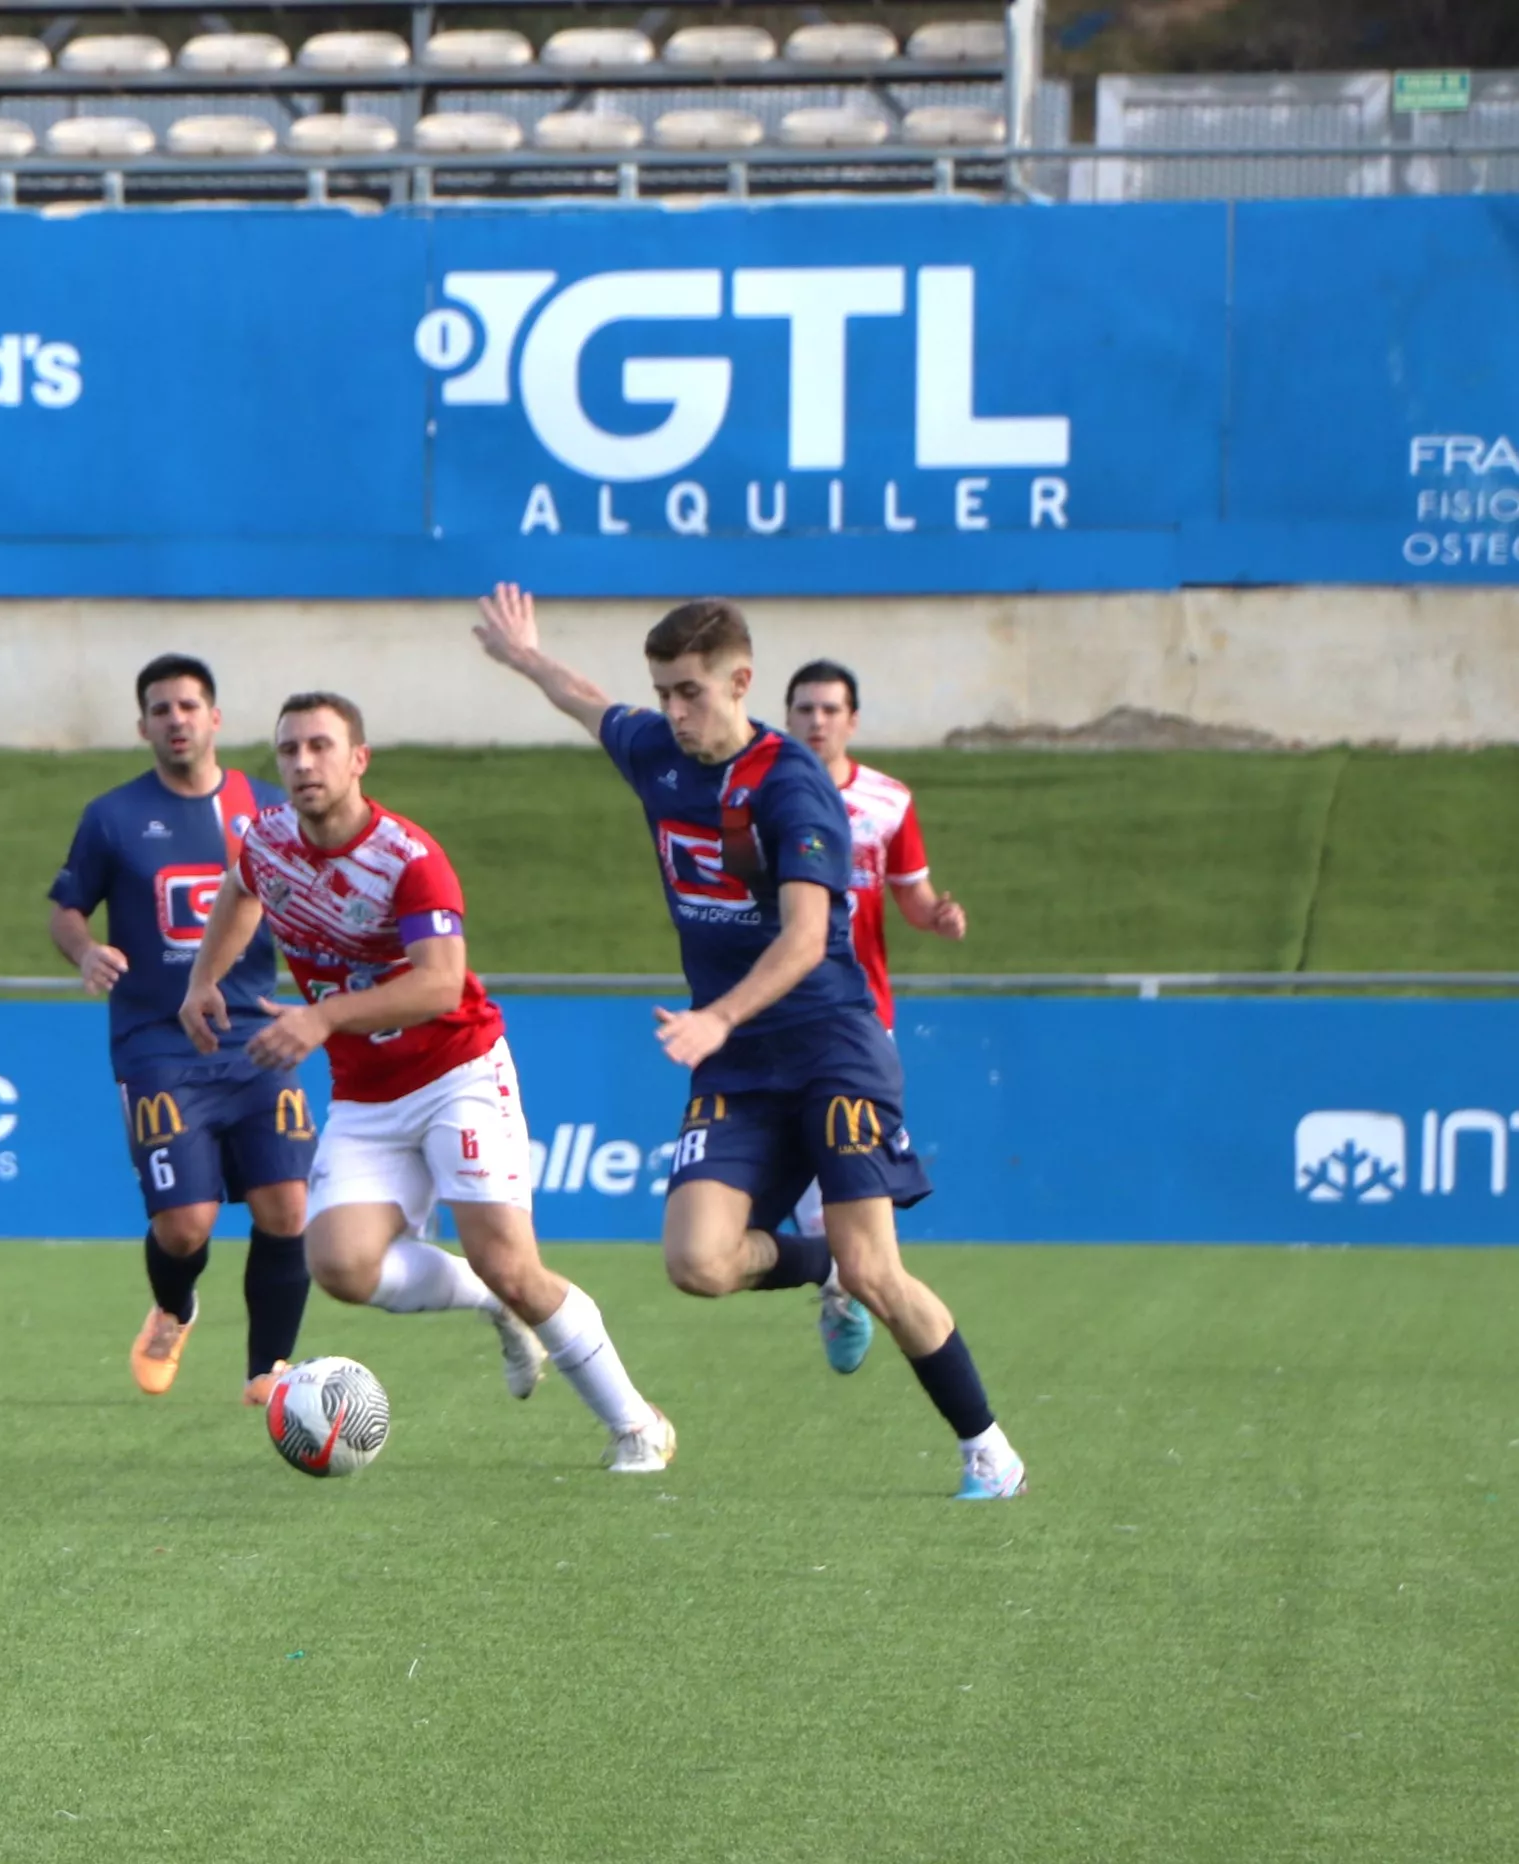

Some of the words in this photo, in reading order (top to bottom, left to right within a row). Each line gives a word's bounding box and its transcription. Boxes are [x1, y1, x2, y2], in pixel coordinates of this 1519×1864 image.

[520, 265, 1070, 482] GTL
[521, 478, 1069, 534] ALQUILER
[1402, 531, 1519, 566] OSTE
[149, 1147, 176, 1192] 6
[672, 1128, 709, 1173] 18
